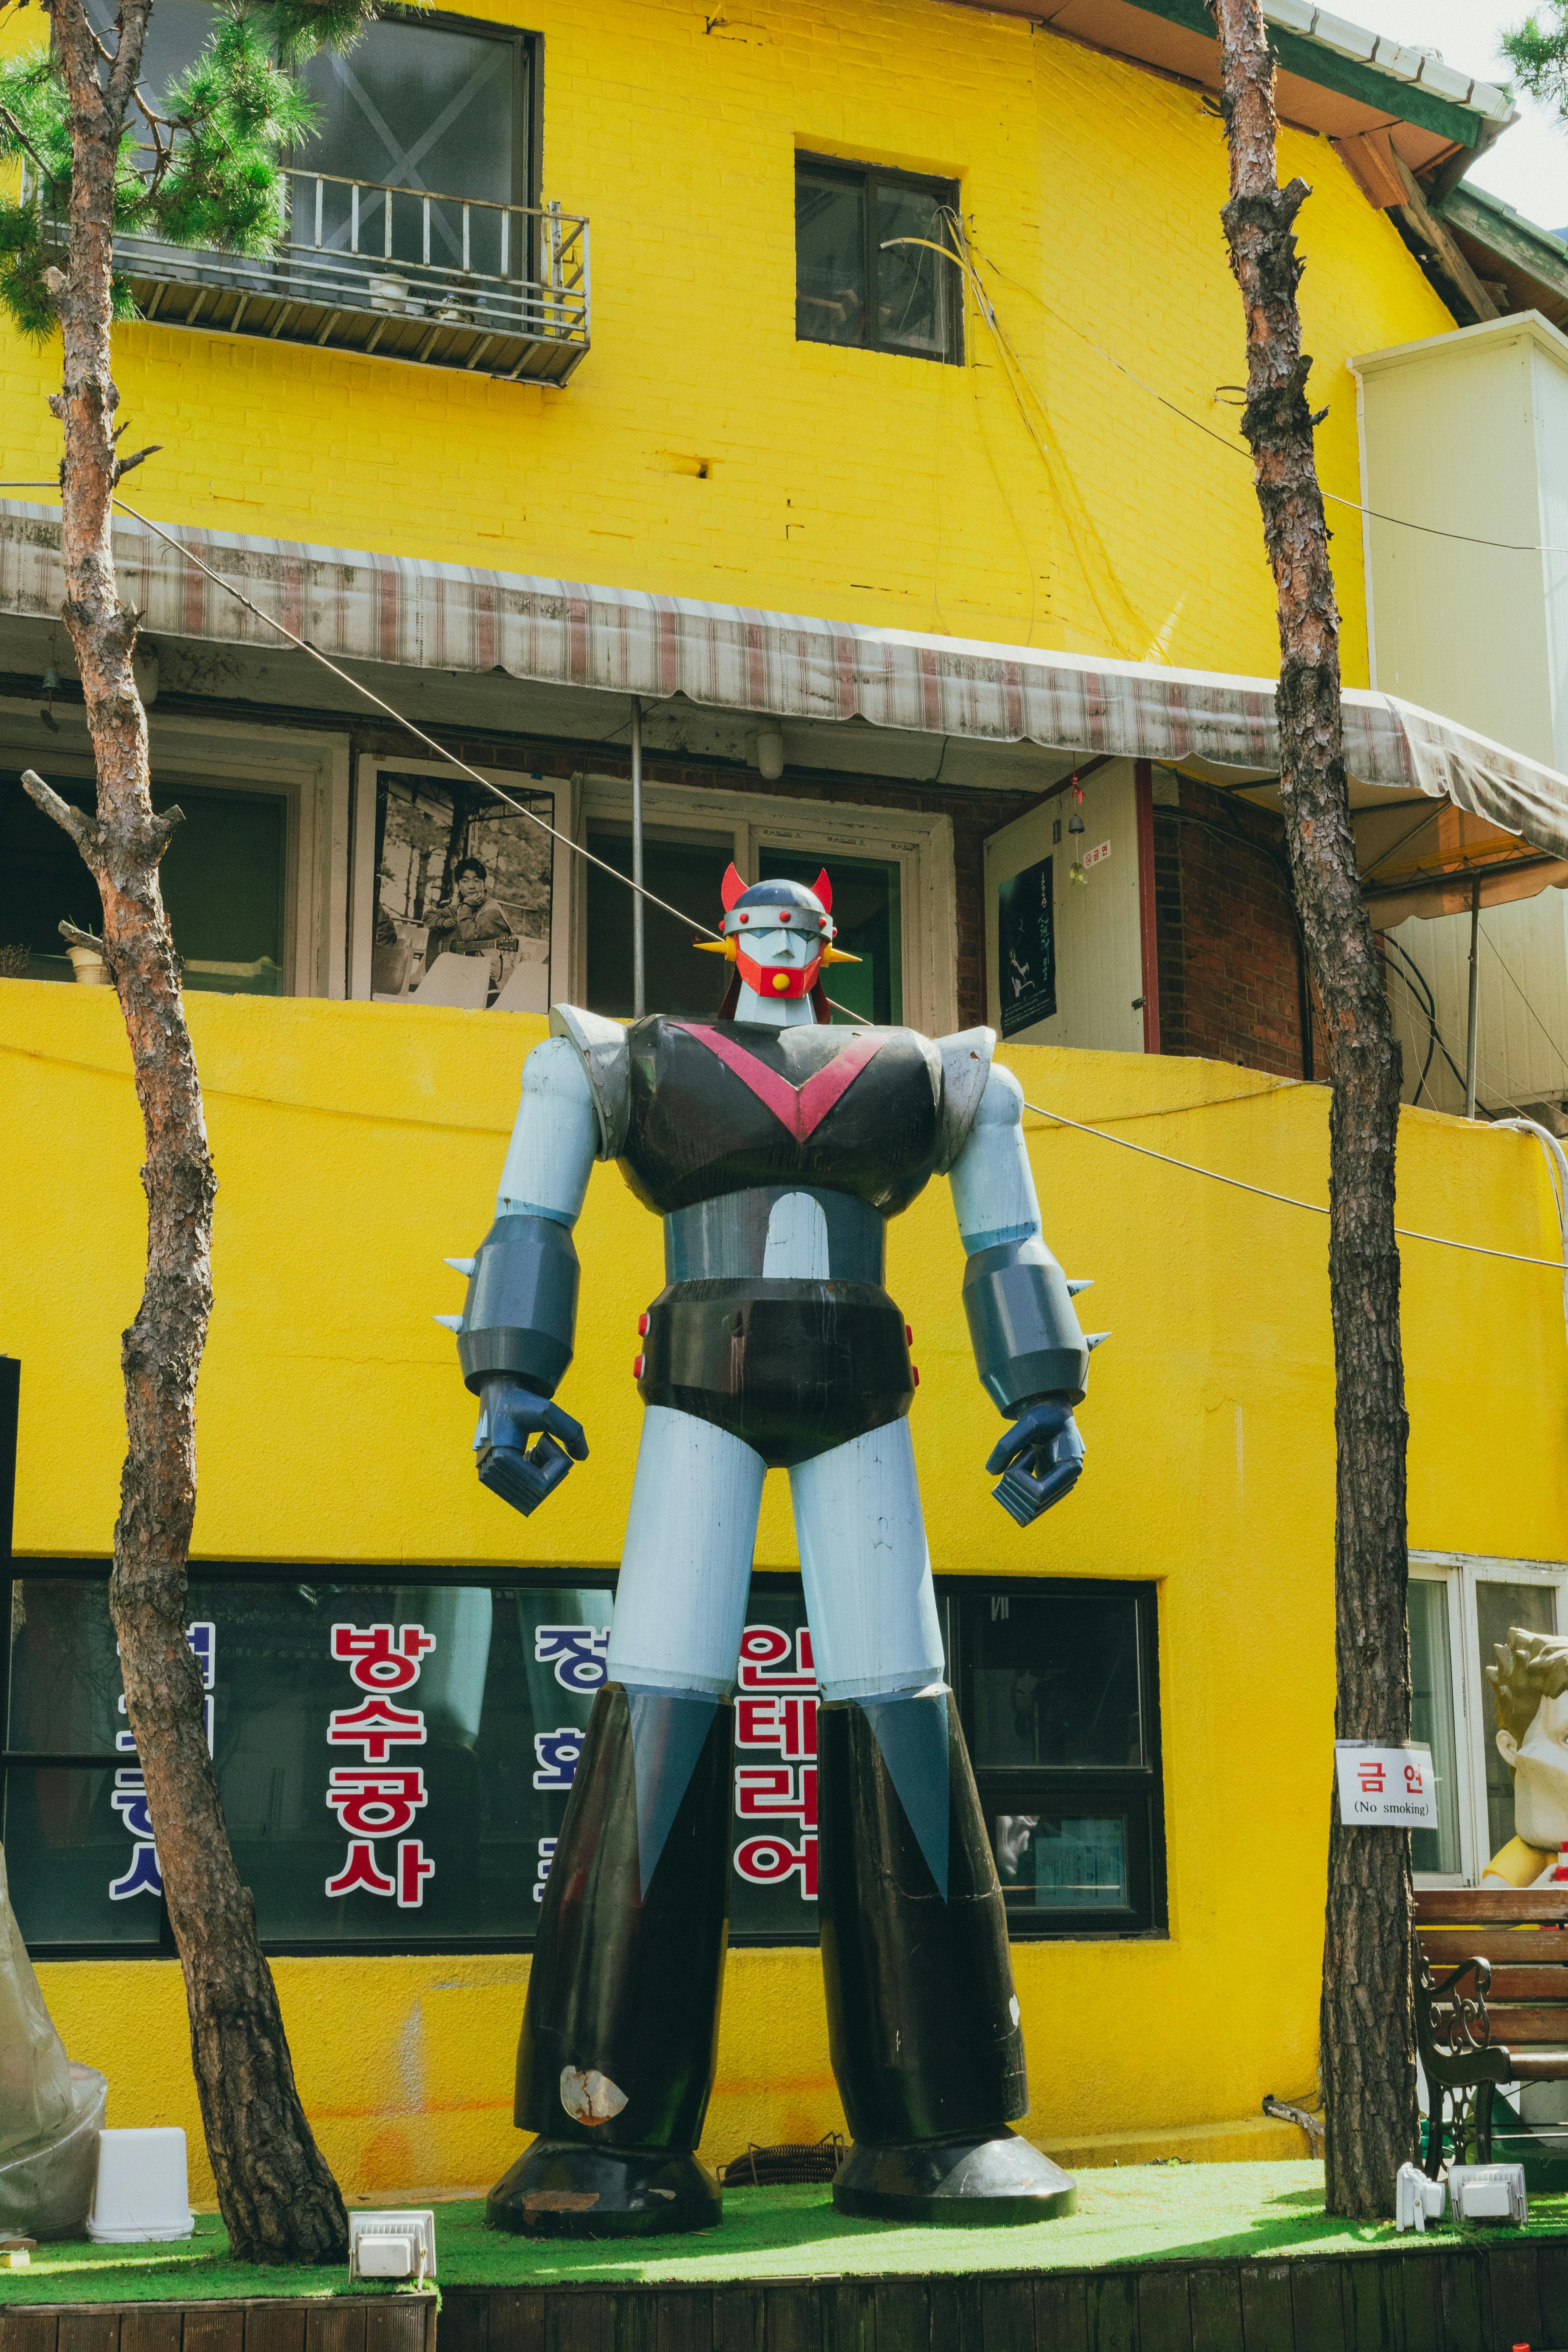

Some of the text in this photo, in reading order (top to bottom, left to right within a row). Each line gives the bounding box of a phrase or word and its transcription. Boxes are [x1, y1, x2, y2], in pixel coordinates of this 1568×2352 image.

[326, 1624, 436, 1907] 방수공사
[733, 1625, 818, 1900] 인테리어
[1354, 1800, 1429, 1816] (No smoking)
